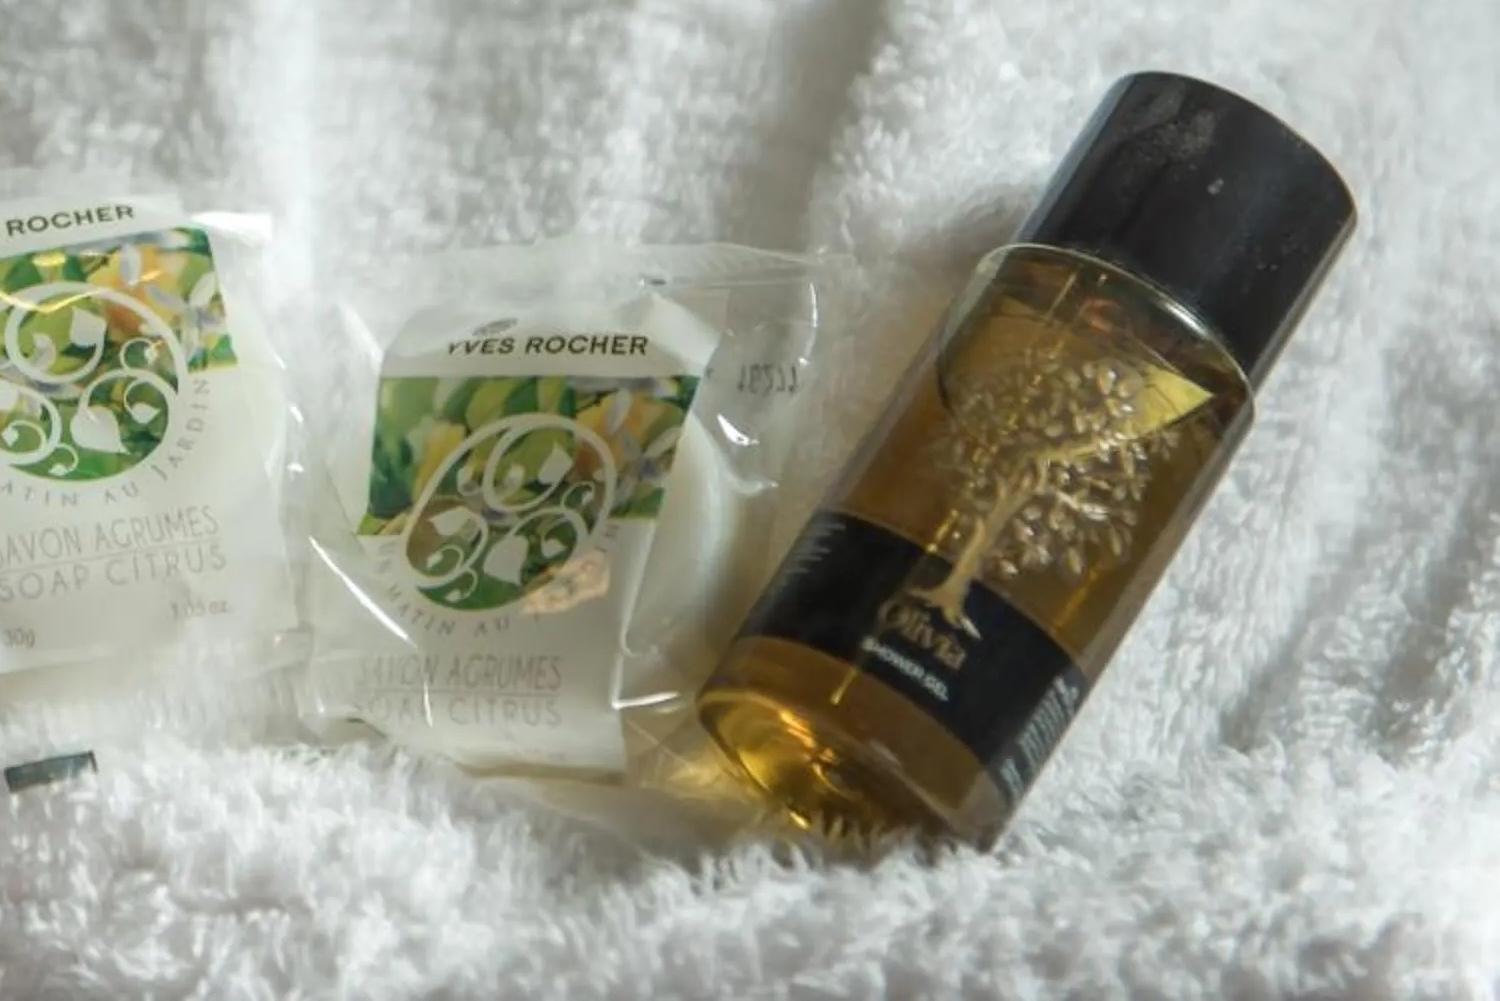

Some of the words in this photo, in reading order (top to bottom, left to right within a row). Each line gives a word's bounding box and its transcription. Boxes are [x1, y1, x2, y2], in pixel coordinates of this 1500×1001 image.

[6, 205, 135, 237] ROCHER
[449, 337, 515, 355] YVES
[524, 335, 649, 356] ROCHER
[104, 481, 139, 503] AU
[152, 379, 210, 480] JARDIN
[94, 505, 220, 551] AGRUMES
[104, 544, 227, 586] CITRUS
[472, 615, 511, 638] AU
[446, 652, 563, 691] AGRUMES
[449, 695, 563, 727] CITRUS
